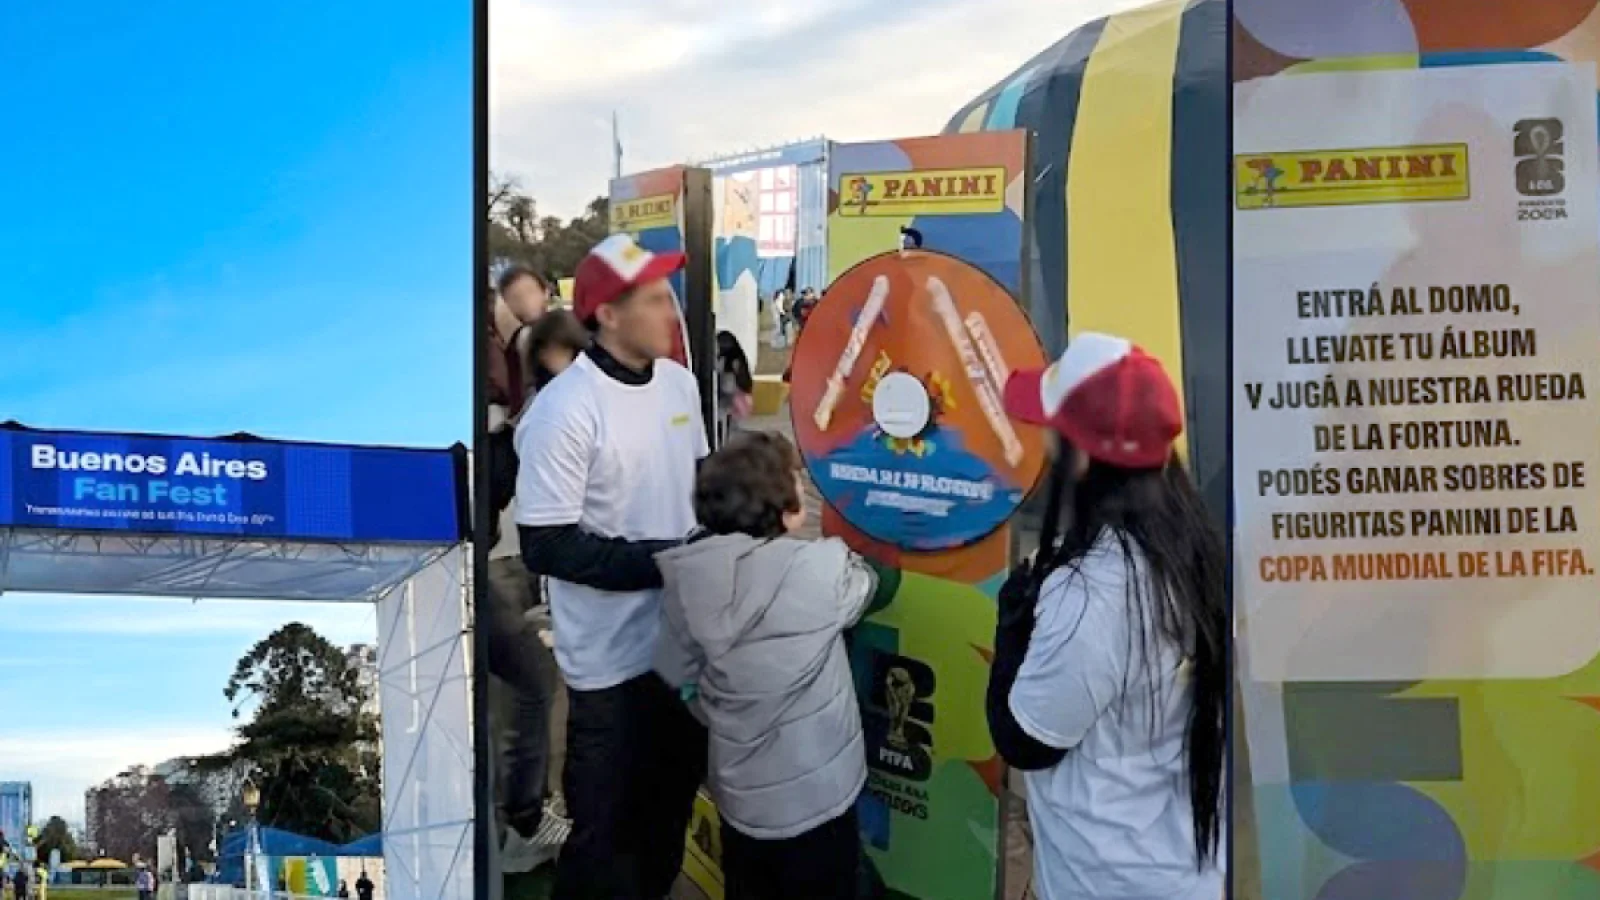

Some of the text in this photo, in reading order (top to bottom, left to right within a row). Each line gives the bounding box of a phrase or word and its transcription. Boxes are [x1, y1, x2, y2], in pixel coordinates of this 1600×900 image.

[1299, 154, 1457, 183] PANINI
[883, 174, 998, 200] PANINI
[1297, 282, 1520, 318] ENTRÁ AL DOMO,
[1287, 326, 1536, 364] LLEVATE TU ÁLBUM
[1269, 375, 1340, 408] JUGÁ
[1344, 378, 1363, 406] A
[1370, 376, 1491, 406] NUESTRA
[1497, 373, 1585, 401] RUEDA
[1314, 419, 1520, 451] DE LA FORTUNA.
[31, 443, 267, 479] Buenos Aires
[74, 478, 228, 506] Fan Fest
[1258, 462, 1585, 496] PODÉS GANAR SOBRES DE
[1272, 506, 1577, 539] FIGURITAS PANINI DE LA
[1260, 549, 1594, 582] COPA MUNDIAL DE LA FIFA.
